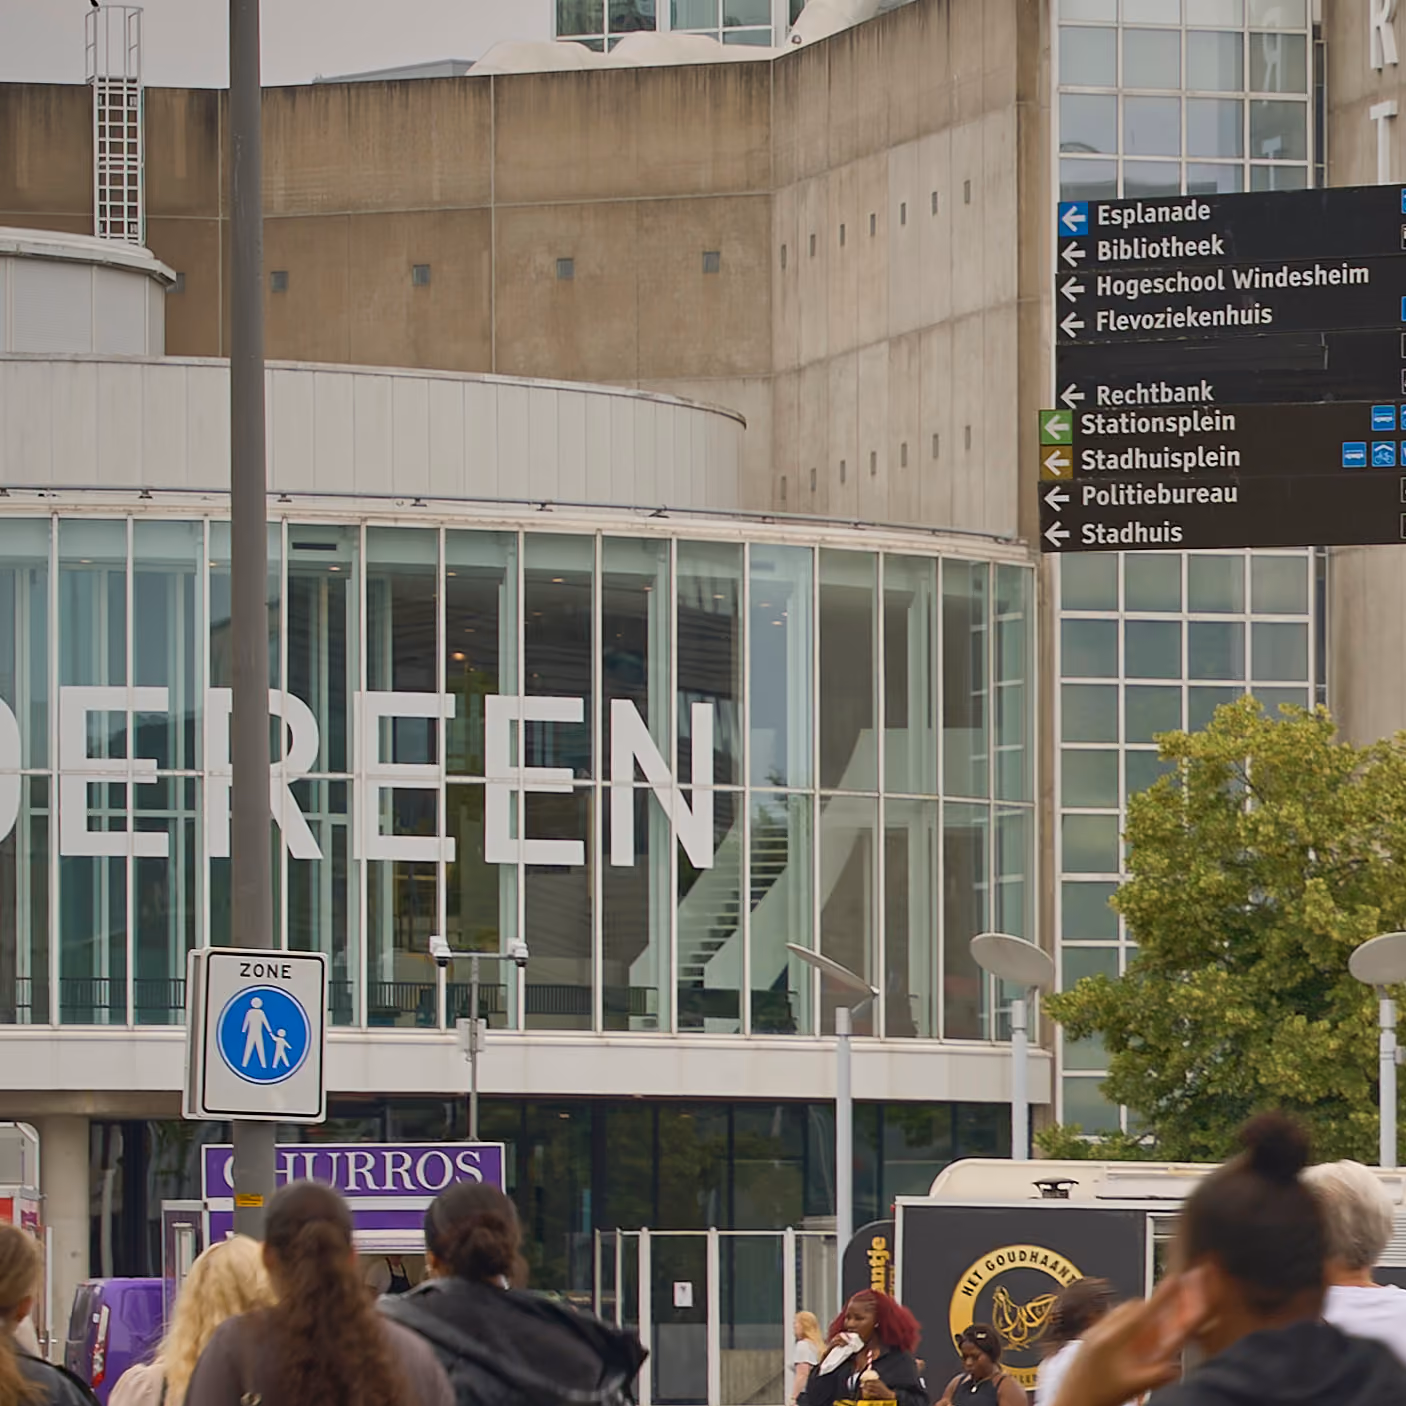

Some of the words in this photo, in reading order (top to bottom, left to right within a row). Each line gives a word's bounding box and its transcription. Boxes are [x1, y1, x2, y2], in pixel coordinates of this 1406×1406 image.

[1097, 200, 1211, 228] Esplanade
[1097, 234, 1224, 261] Bibliotheek
[1096, 268, 1225, 300] Hogeschool
[1232, 263, 1369, 290] Windesheim
[1096, 305, 1272, 333] Flevoziekenhuis
[1096, 380, 1214, 406] Rechtbank
[1081, 410, 1235, 440] Stationsplein
[1081, 446, 1240, 475] Stadhuisplein
[1082, 483, 1238, 507] Politiebureau
[1081, 522, 1183, 544] Stadhuis
[0, 686, 714, 869] EREEN
[240, 963, 292, 980] ZONE
[961, 1270, 984, 1297] HET
[985, 1250, 1078, 1285] GOUDHAANT
